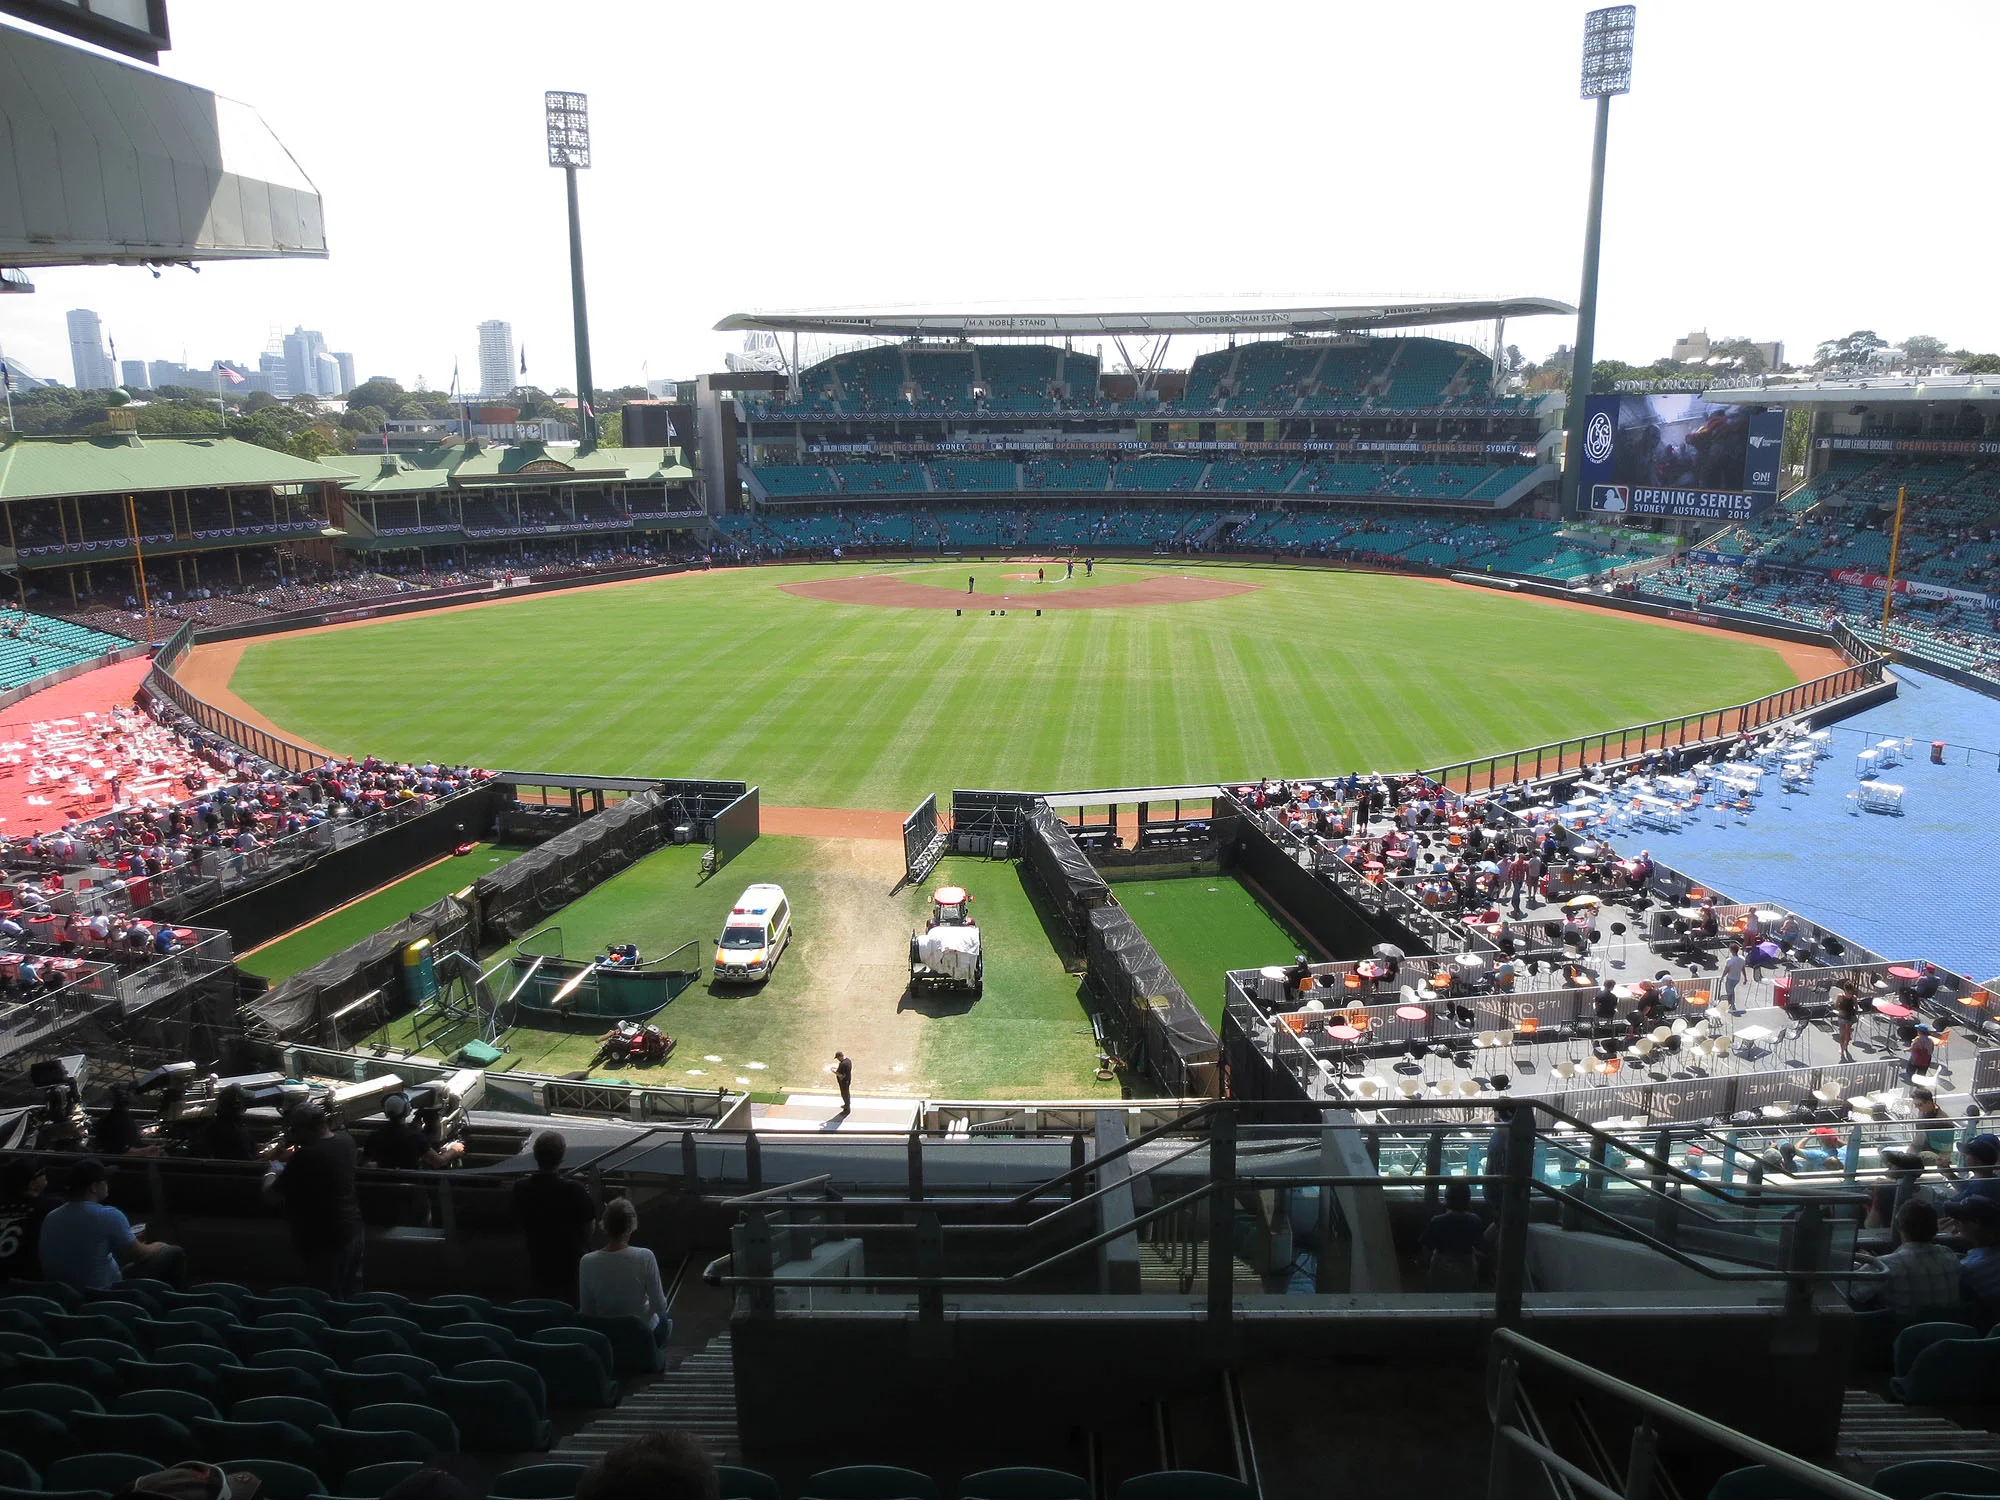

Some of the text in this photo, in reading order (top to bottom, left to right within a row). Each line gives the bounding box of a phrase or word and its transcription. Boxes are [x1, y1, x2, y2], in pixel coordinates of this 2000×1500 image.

[1198, 313, 1289, 324] DON BRADMAN STAND
[1614, 376, 1764, 391] SYDNEY CRICKET GROUND
[1486, 444, 1516, 452] SYDNEY
[1834, 439, 2000, 453] MAJOR LEAGUE BASEBALL OPENING SERIES SYD
[1752, 472, 1770, 482] ON!
[1634, 489, 1752, 510] OPENING SERIES
[1634, 504, 1750, 520] SYDNEY AUSTRALIA 2014
[1916, 589, 1944, 598] QANTAS
[1954, 594, 1982, 606] QANTAS
